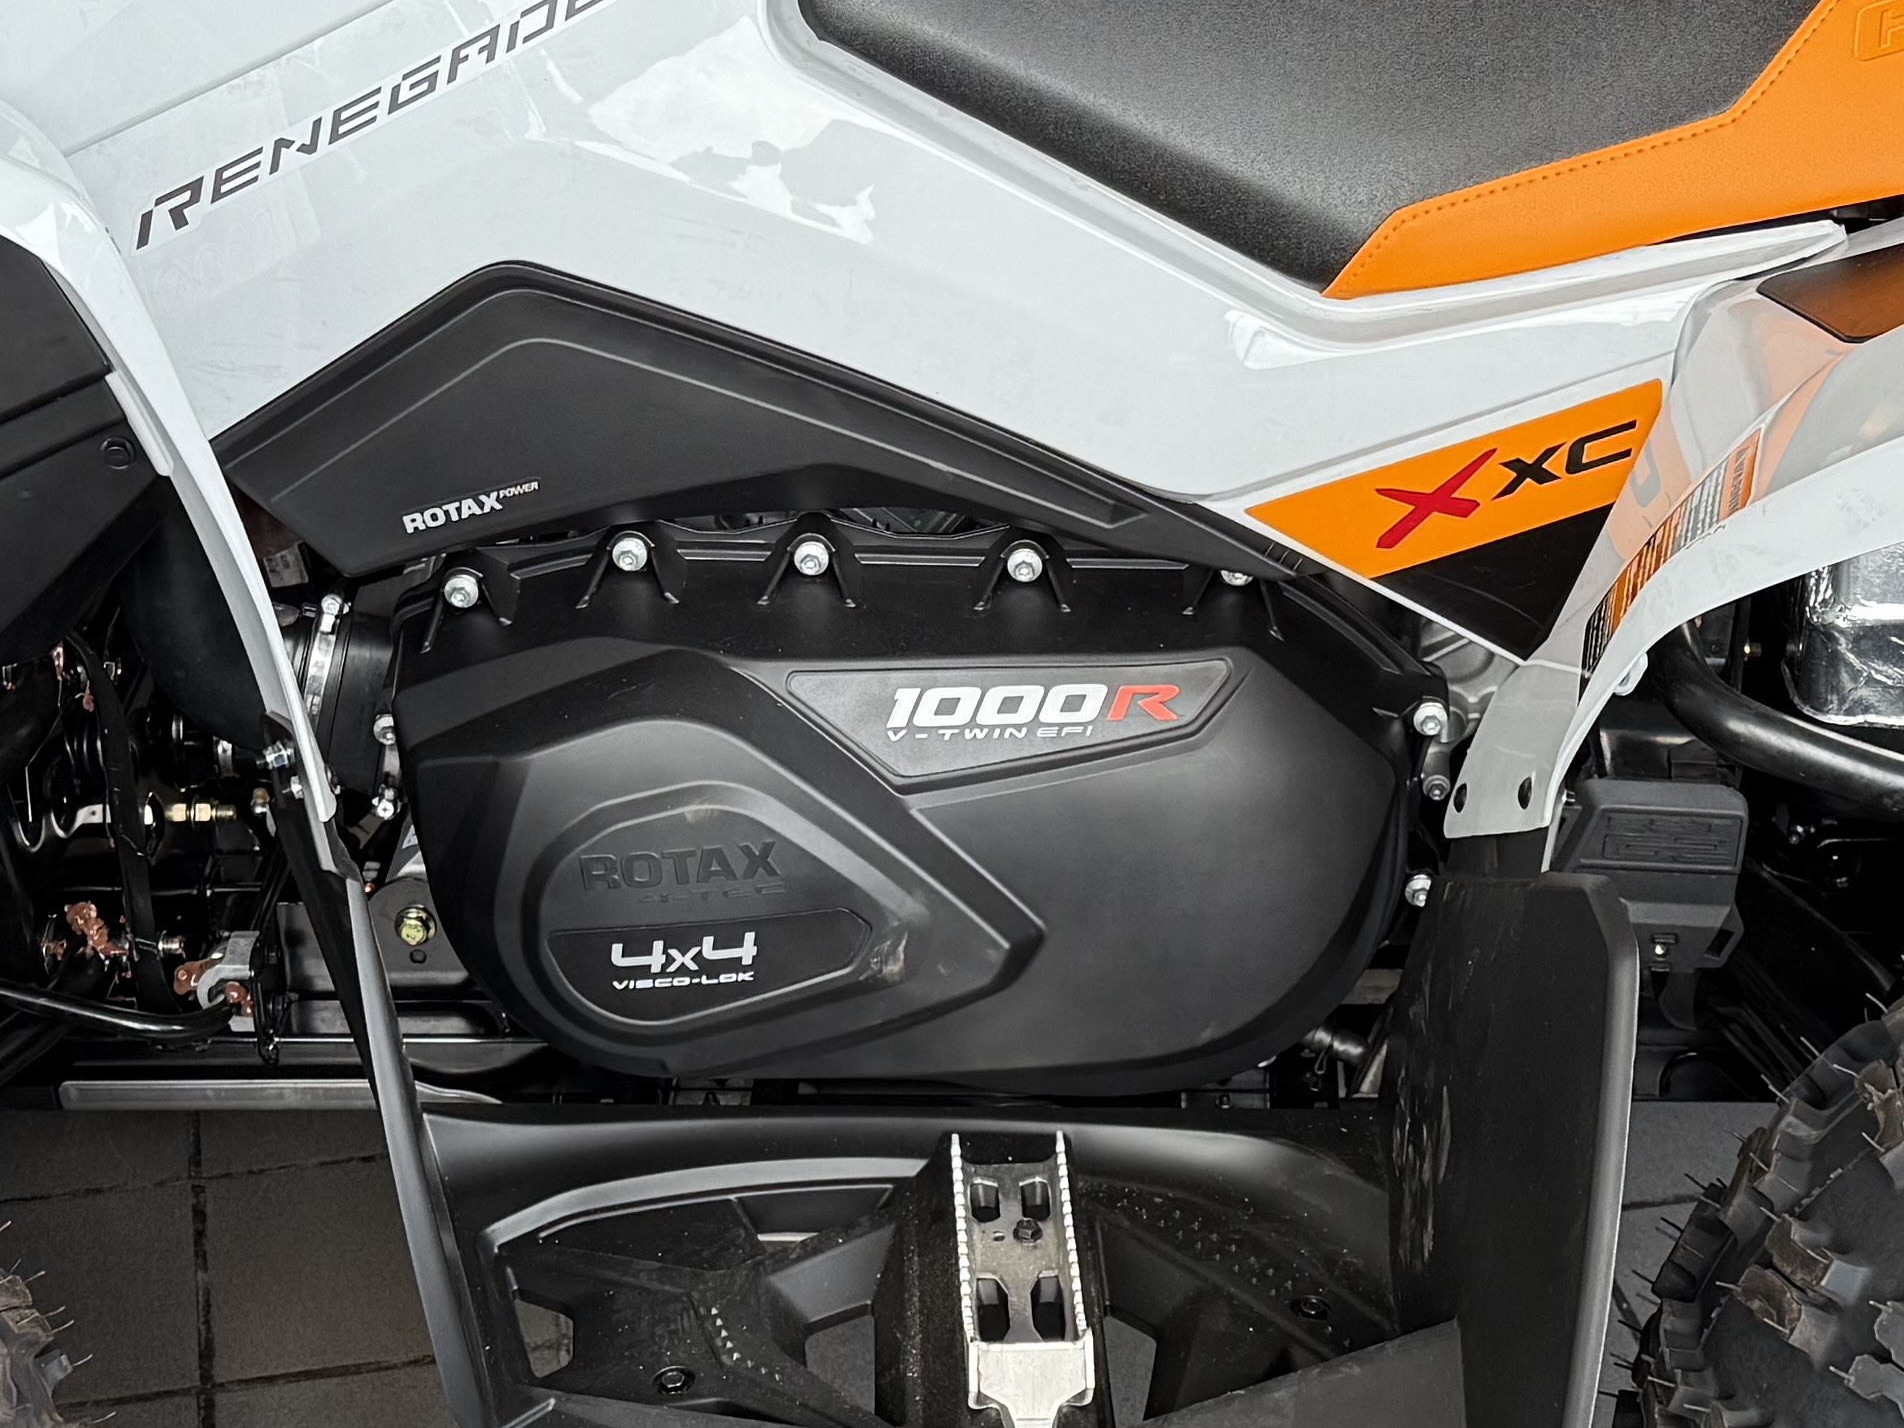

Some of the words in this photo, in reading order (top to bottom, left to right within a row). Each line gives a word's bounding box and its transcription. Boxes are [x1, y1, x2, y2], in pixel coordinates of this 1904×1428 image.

[402, 492, 502, 534] ROTAX
[499, 481, 540, 499] POWER
[1374, 448, 1496, 549] X
[886, 683, 1181, 729] 1000R
[886, 726, 1032, 743] V-TWIN
[1036, 724, 1094, 740] EFI
[579, 839, 782, 893] ROTAX
[610, 930, 758, 974] 4x4
[611, 971, 756, 991] VISCO-LOK
